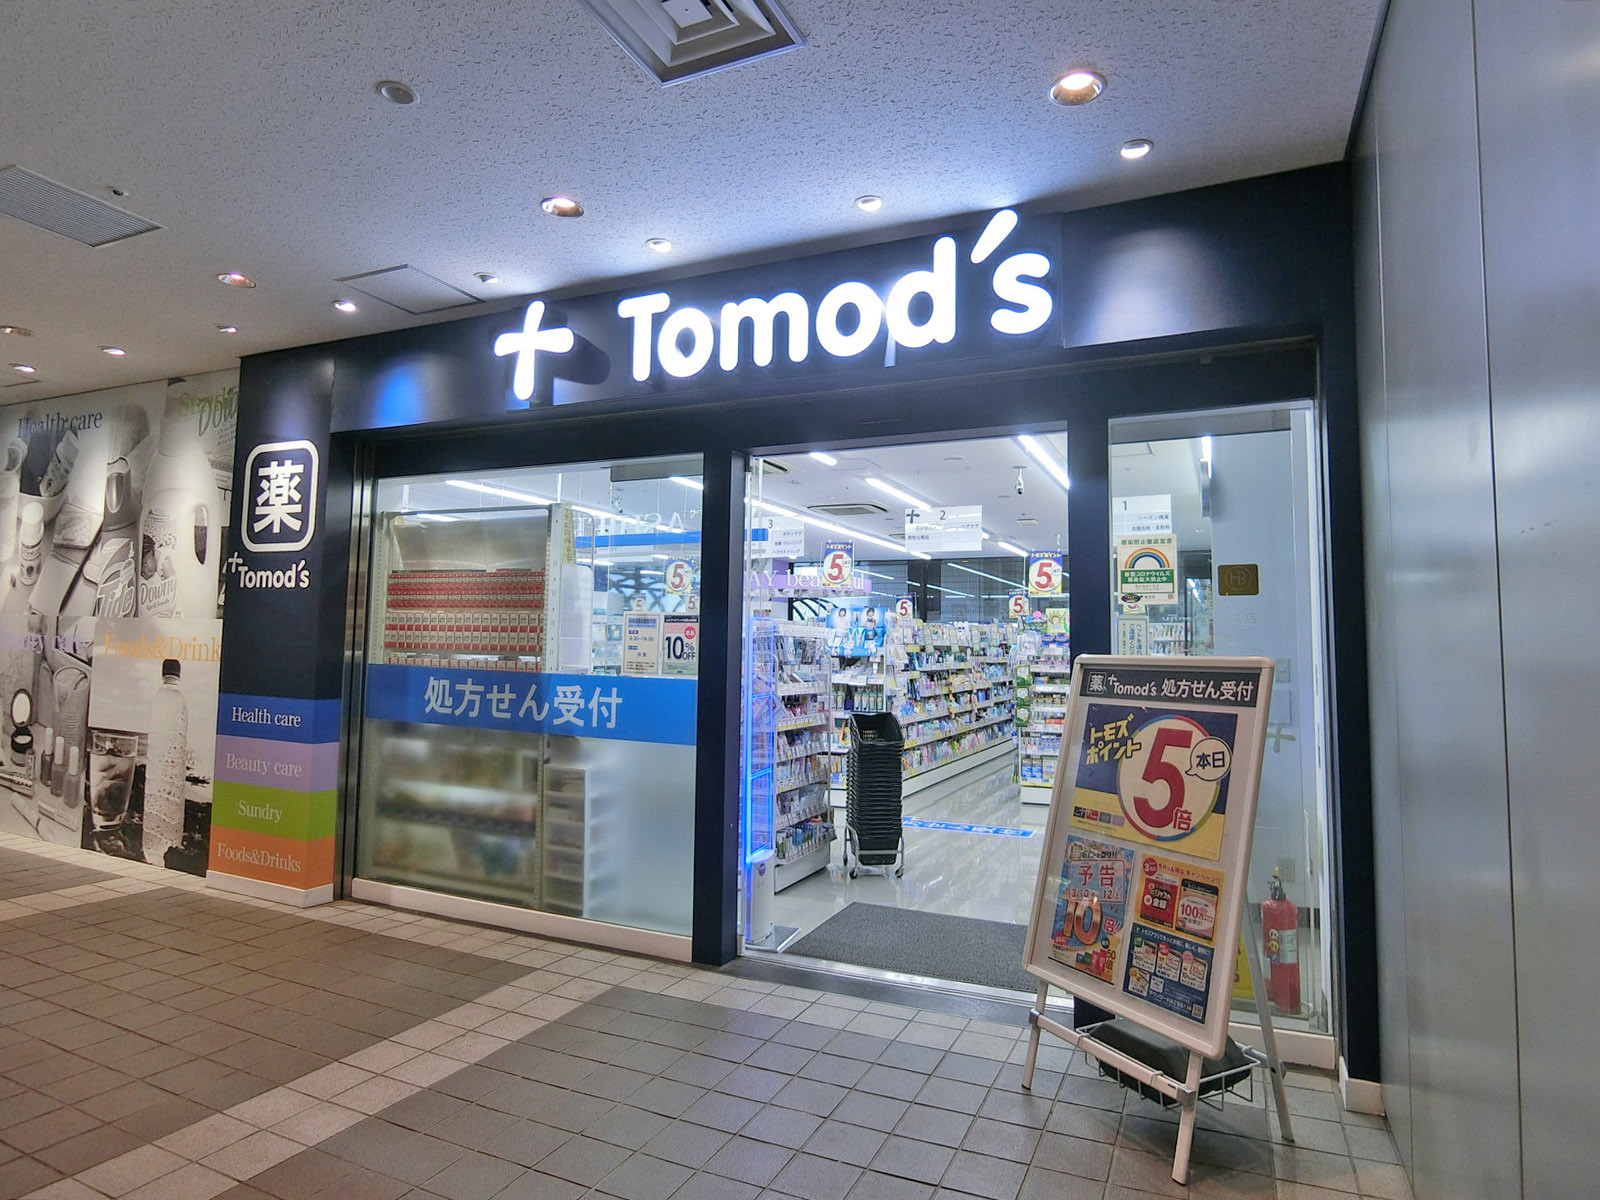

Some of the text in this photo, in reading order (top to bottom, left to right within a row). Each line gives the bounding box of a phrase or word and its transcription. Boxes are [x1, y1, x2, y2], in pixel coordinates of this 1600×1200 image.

[617, 208, 1053, 382] Tomod's
[253, 459, 304, 533] 薬
[1122, 500, 1127, 511] 1
[768, 519, 774, 529] 3
[940, 510, 946, 520] 2
[238, 559, 310, 589] Tomod's
[671, 563, 685, 589] 5
[828, 553, 844, 581] 5
[1034, 562, 1052, 589] 5
[899, 600, 909, 617] 5
[1013, 597, 1024, 614] 5
[424, 675, 623, 729] 処方せん受付
[1113, 681, 1157, 697] Tomod's
[1161, 680, 1254, 701] 処方せん受付
[232, 707, 302, 728] Health care
[1089, 713, 1135, 744] トモズ
[1085, 739, 1142, 765] ポイント
[1196, 750, 1226, 770] 本日
[226, 753, 302, 778] Beauty care
[1133, 727, 1194, 829] 5
[238, 799, 283, 823] Sundry
[1172, 806, 1192, 832] 倍
[217, 842, 302, 873] Foods&Drinks
[1078, 864, 1115, 888] 予告
